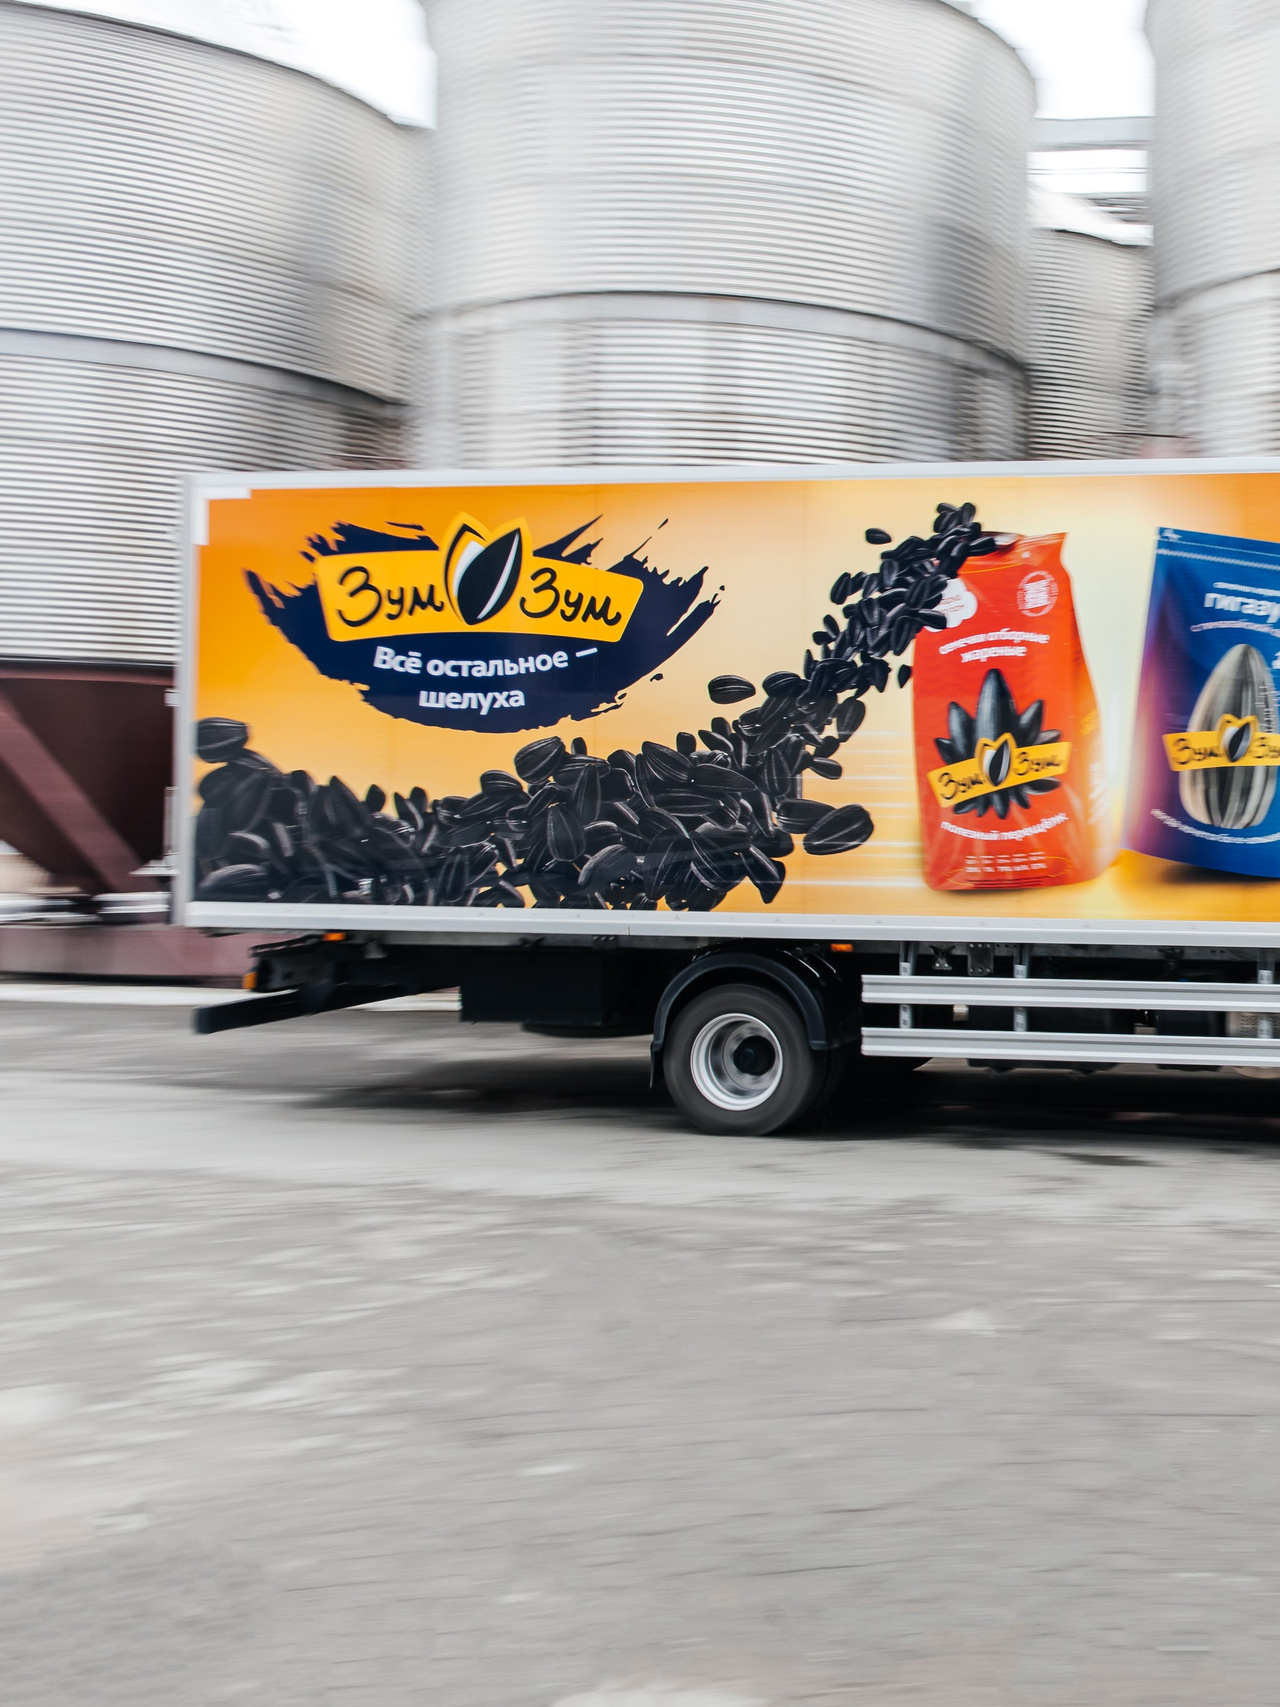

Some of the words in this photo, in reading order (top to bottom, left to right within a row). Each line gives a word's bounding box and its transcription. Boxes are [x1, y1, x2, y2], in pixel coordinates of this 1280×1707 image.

[337, 566, 445, 627] Зум
[519, 568, 622, 626] Зум
[373, 645, 422, 674] Всё
[427, 651, 569, 677] остальное
[419, 688, 525, 715] шелуха
